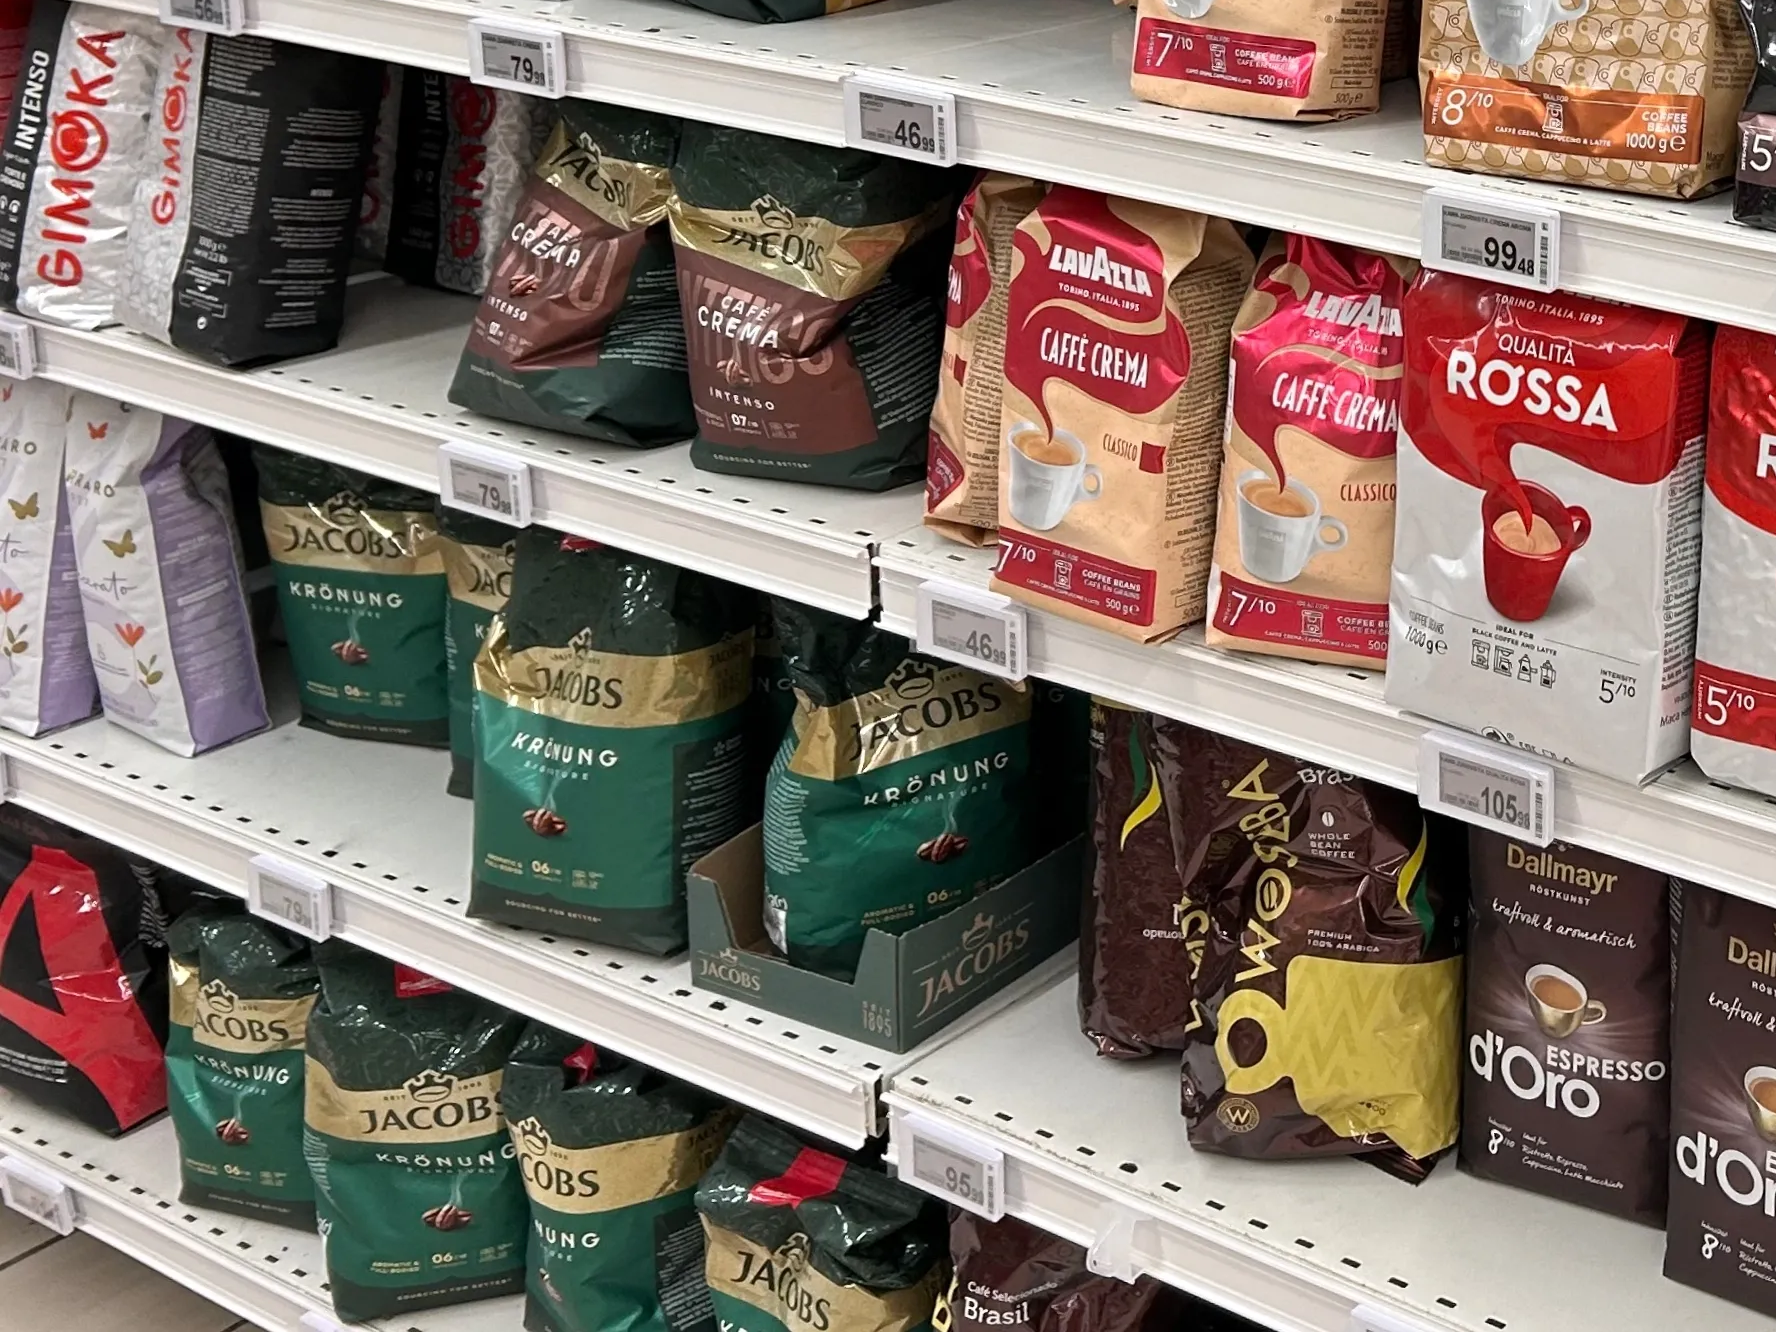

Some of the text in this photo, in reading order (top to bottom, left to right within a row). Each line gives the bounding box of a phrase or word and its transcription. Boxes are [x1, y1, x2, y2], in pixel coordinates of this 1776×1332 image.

[13, 50, 51, 151] INTENSO
[1641, 110, 1688, 124] COFFEE
[37, 29, 126, 287] GIMOKA
[511, 223, 581, 269] CREMA
[1048, 244, 1153, 298] LAVAZZA
[697, 307, 779, 350] CREMA
[1041, 326, 1148, 389] CAFFÈ CREMA
[710, 388, 775, 411] INTENSO
[1447, 349, 1619, 434] ROSSA
[1102, 433, 1137, 461] CLASSICO
[1340, 483, 1397, 503] CLASSICO
[289, 580, 404, 609] KRÖNUNG
[850, 681, 1003, 763] JACOBS
[864, 751, 1010, 807] KRÖNUNG
[1308, 832, 1351, 842] WHOLE
[1310, 841, 1341, 850] BEAN
[1506, 841, 1619, 896] Dallmayr
[1307, 928, 1352, 941] PREMIUM
[1307, 937, 1380, 953] 100% ARABICA
[700, 959, 762, 993] JACOBS
[916, 917, 1030, 1018] JACOBS
[1469, 1029, 1601, 1119] d'Oro
[1546, 1045, 1667, 1082] ESPRESSO
[964, 1297, 1029, 1325] Brasil
